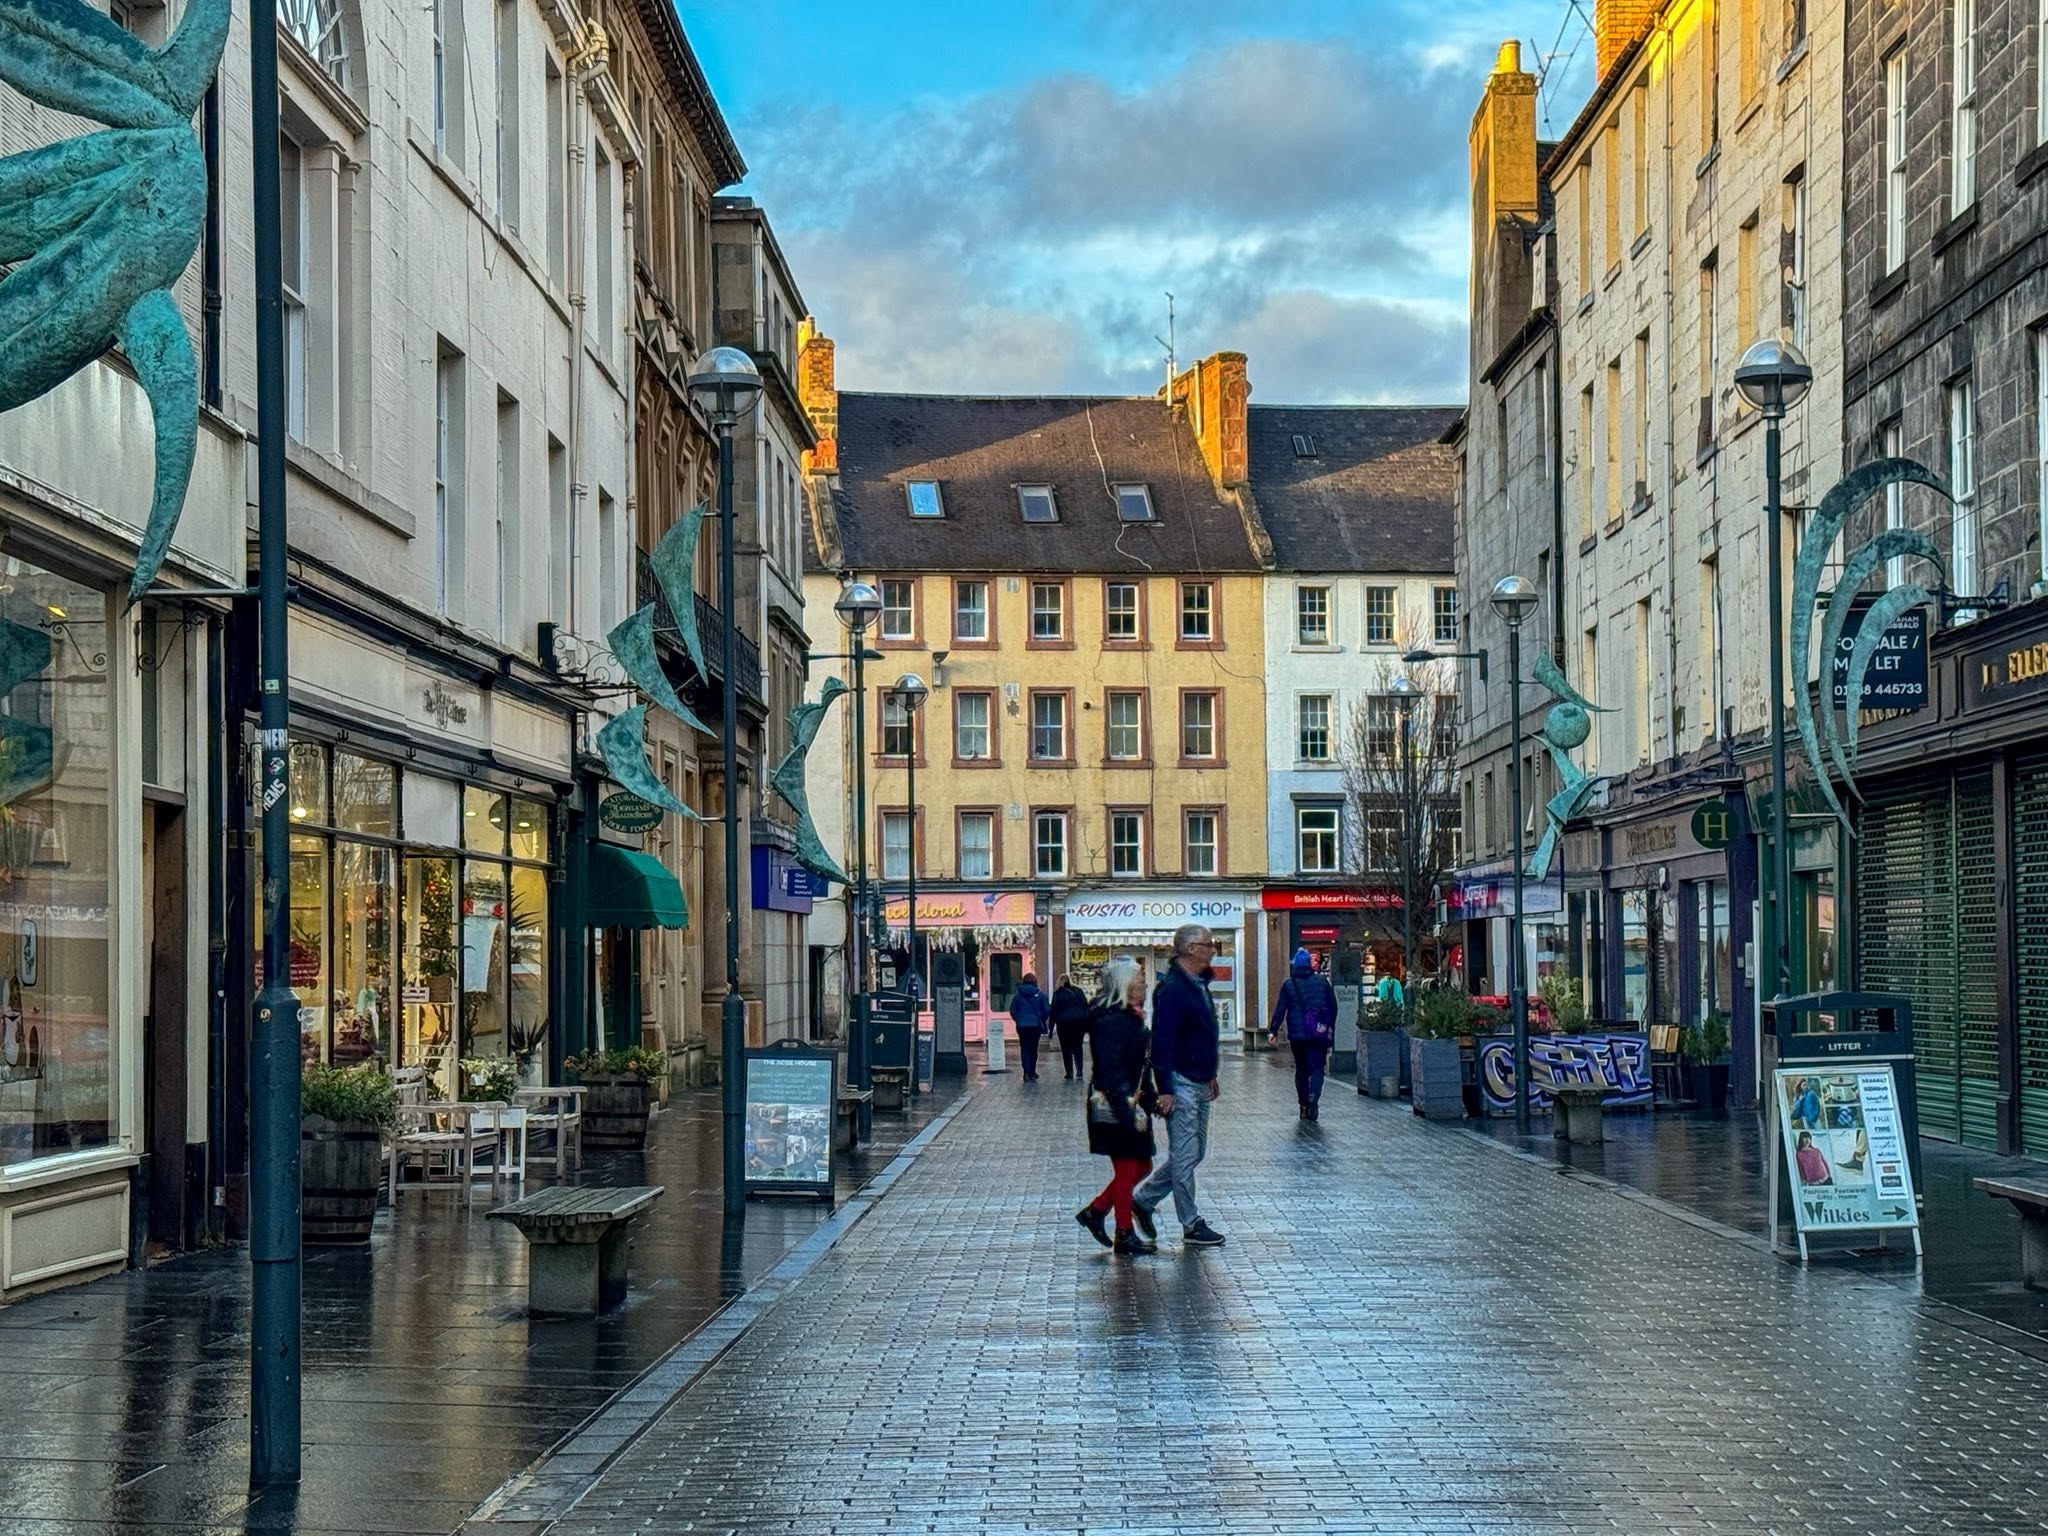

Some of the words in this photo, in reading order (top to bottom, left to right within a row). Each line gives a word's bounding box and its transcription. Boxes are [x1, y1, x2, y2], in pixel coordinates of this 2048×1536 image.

[1875, 635, 1908, 650] ALE
[1875, 656, 1902, 671] LET
[1834, 685, 1872, 696] 018
[1875, 683, 1922, 695] 445733
[1701, 811, 1729, 842] H
[1294, 894, 1321, 904] British
[1321, 894, 1344, 903] Heart
[886, 904, 909, 920] ice
[915, 901, 966, 919] cloud
[1075, 903, 1136, 917] RUSTIC
[1142, 902, 1186, 917] FOOD
[1190, 902, 1232, 917] SHOP
[1828, 1042, 1862, 1051] LITTER
[1834, 1186, 1867, 1194] Footwear
[1804, 1201, 1871, 1225] Wilkies
